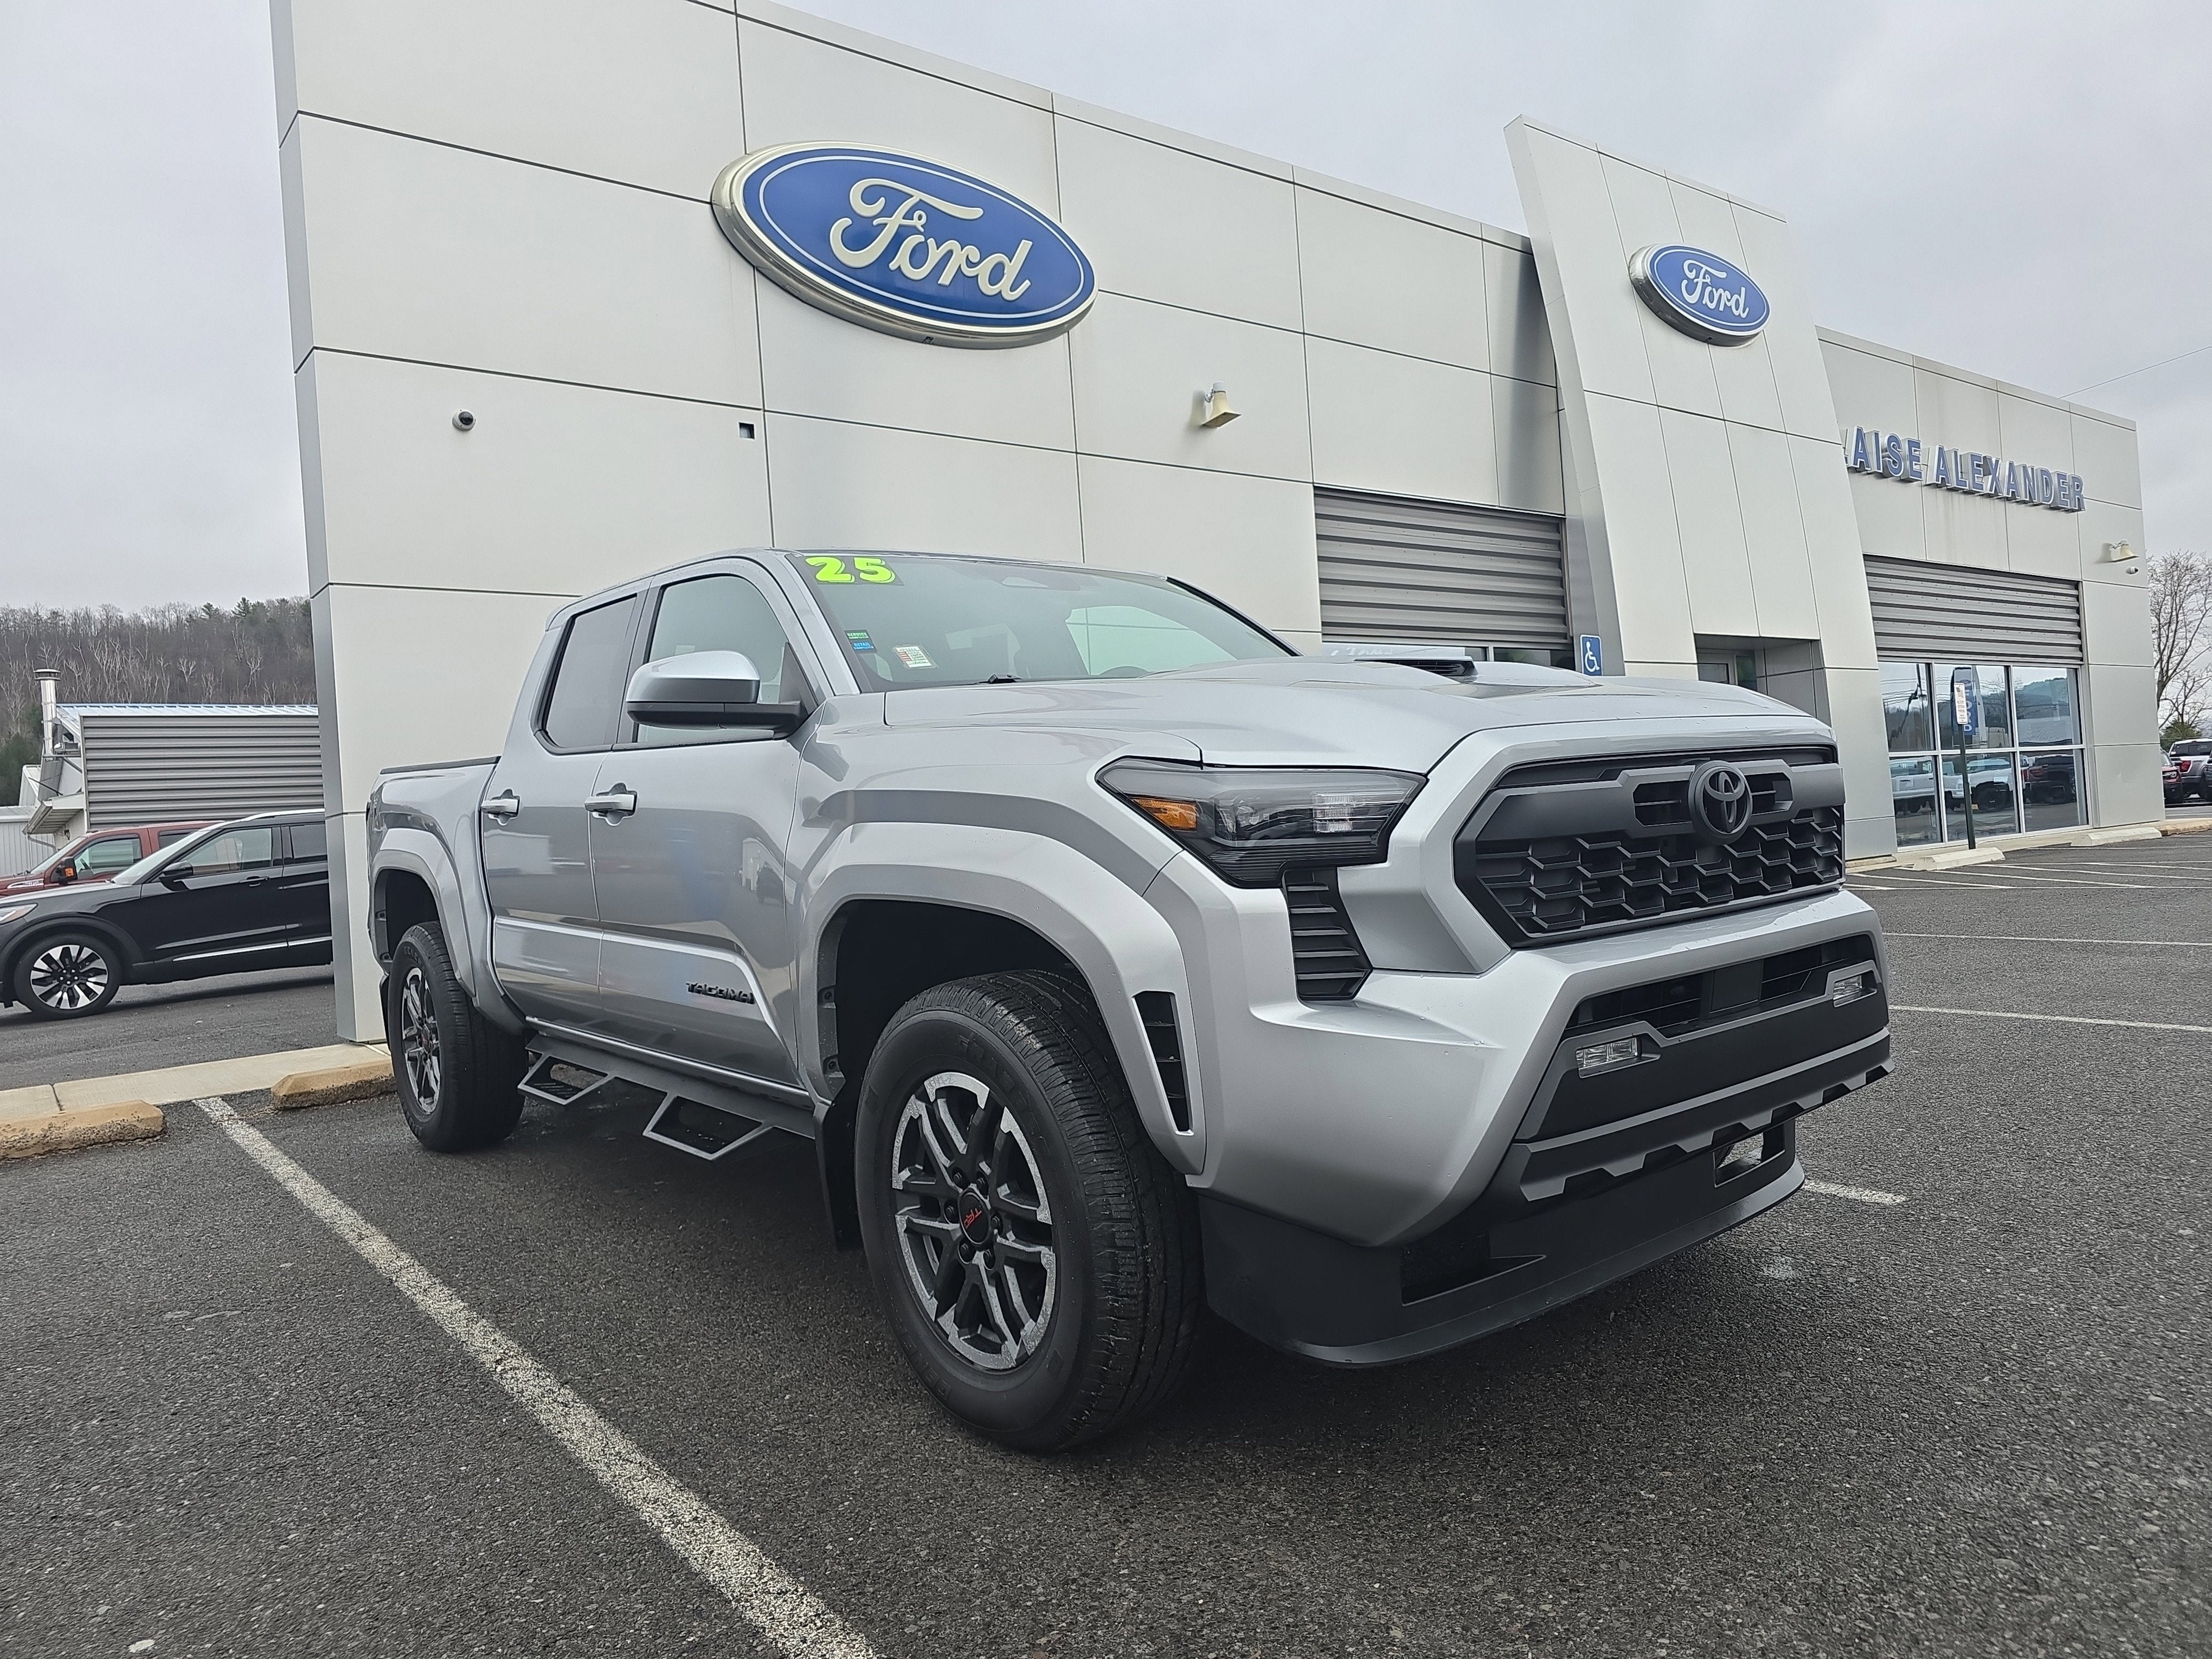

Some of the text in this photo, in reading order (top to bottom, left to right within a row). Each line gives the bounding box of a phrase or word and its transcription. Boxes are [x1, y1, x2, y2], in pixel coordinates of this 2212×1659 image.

[830, 178, 1033, 301] Ford
[1681, 259, 1749, 318] Ford
[1844, 426, 2086, 512] AISE ALEXANDER
[805, 556, 896, 584] 25
[685, 981, 755, 1005] TACOMA
